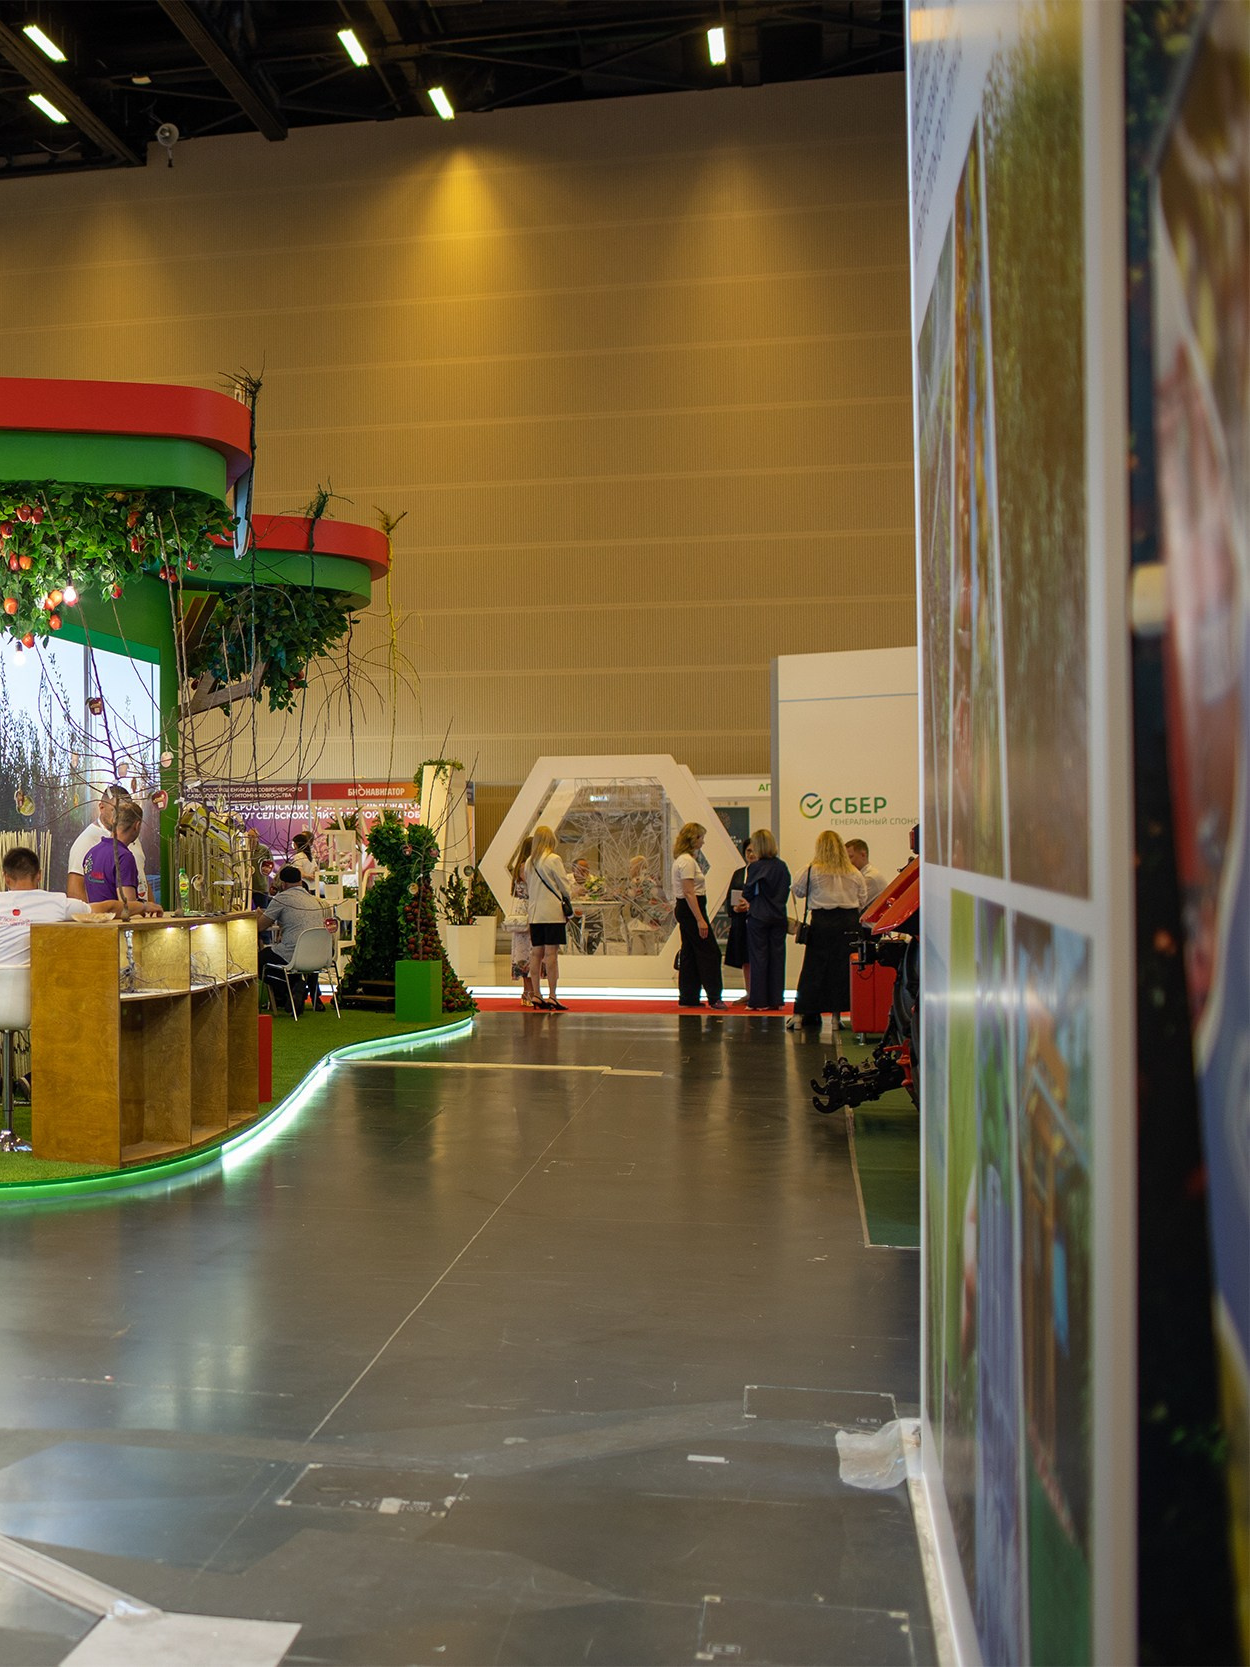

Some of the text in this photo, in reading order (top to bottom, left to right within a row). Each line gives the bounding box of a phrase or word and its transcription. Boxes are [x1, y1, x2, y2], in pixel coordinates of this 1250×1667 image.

[347, 785, 405, 797] БИОНАВИГАТОР
[829, 796, 887, 814] СБЕР
[830, 817, 887, 825] ГЕНЕРАЛЬНЫЙ
